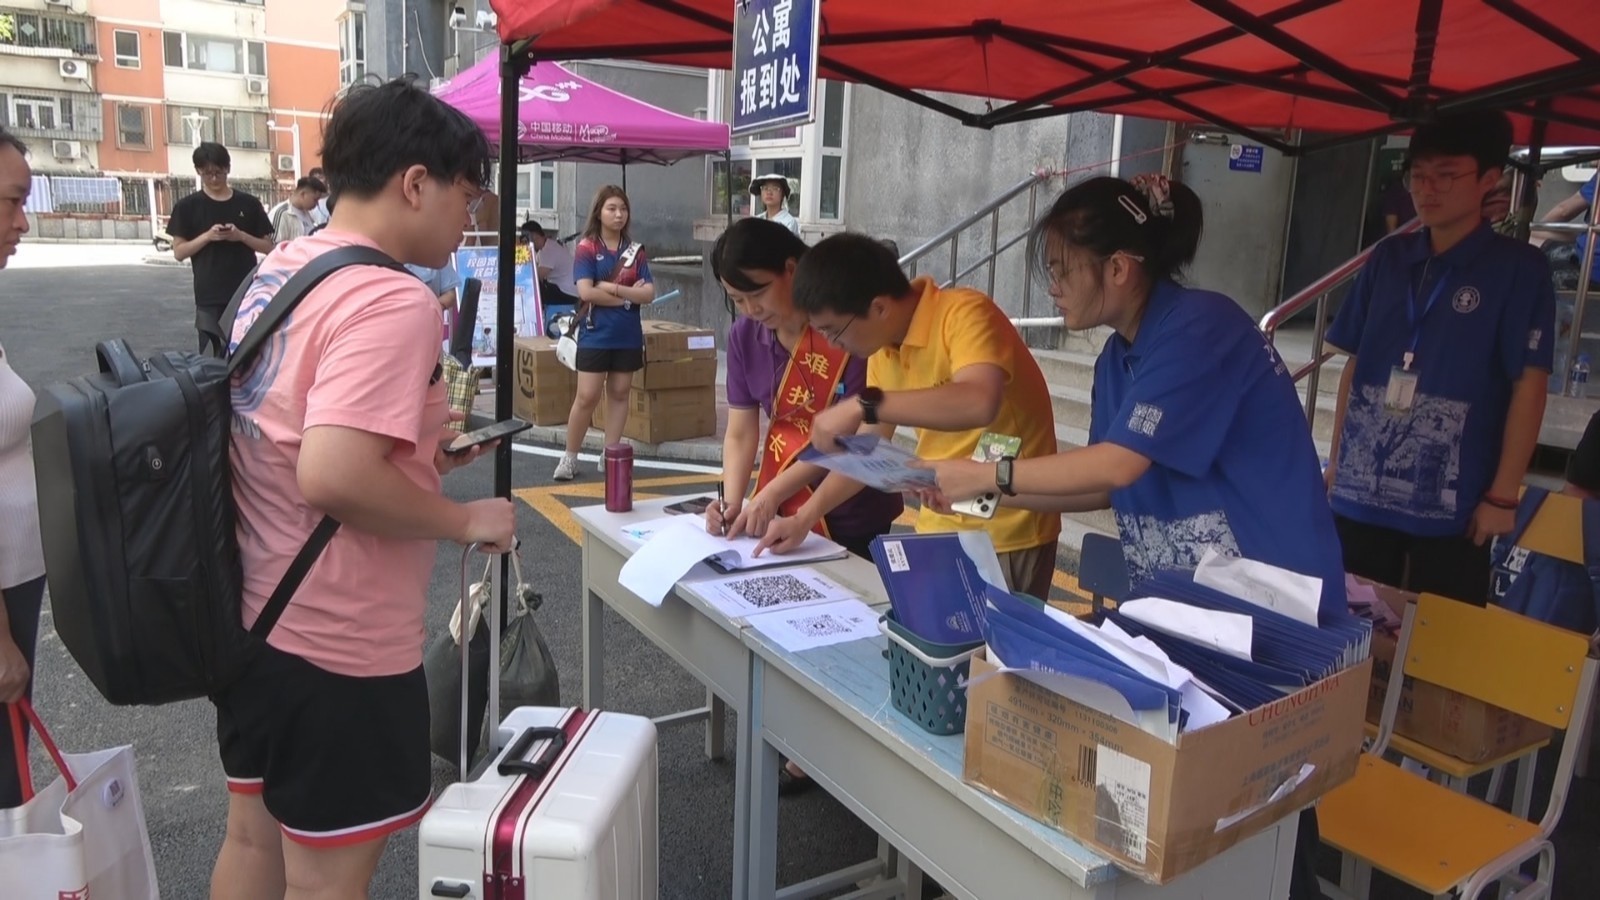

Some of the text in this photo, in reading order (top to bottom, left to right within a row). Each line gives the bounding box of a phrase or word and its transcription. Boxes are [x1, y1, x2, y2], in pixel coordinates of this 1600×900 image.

[751, 0, 793, 57] 公寓
[740, 53, 801, 116] 报到处
[530, 121, 573, 134] 中国移动
[530, 133, 572, 142] China Mobile
[1047, 711, 1080, 734] 320mm
